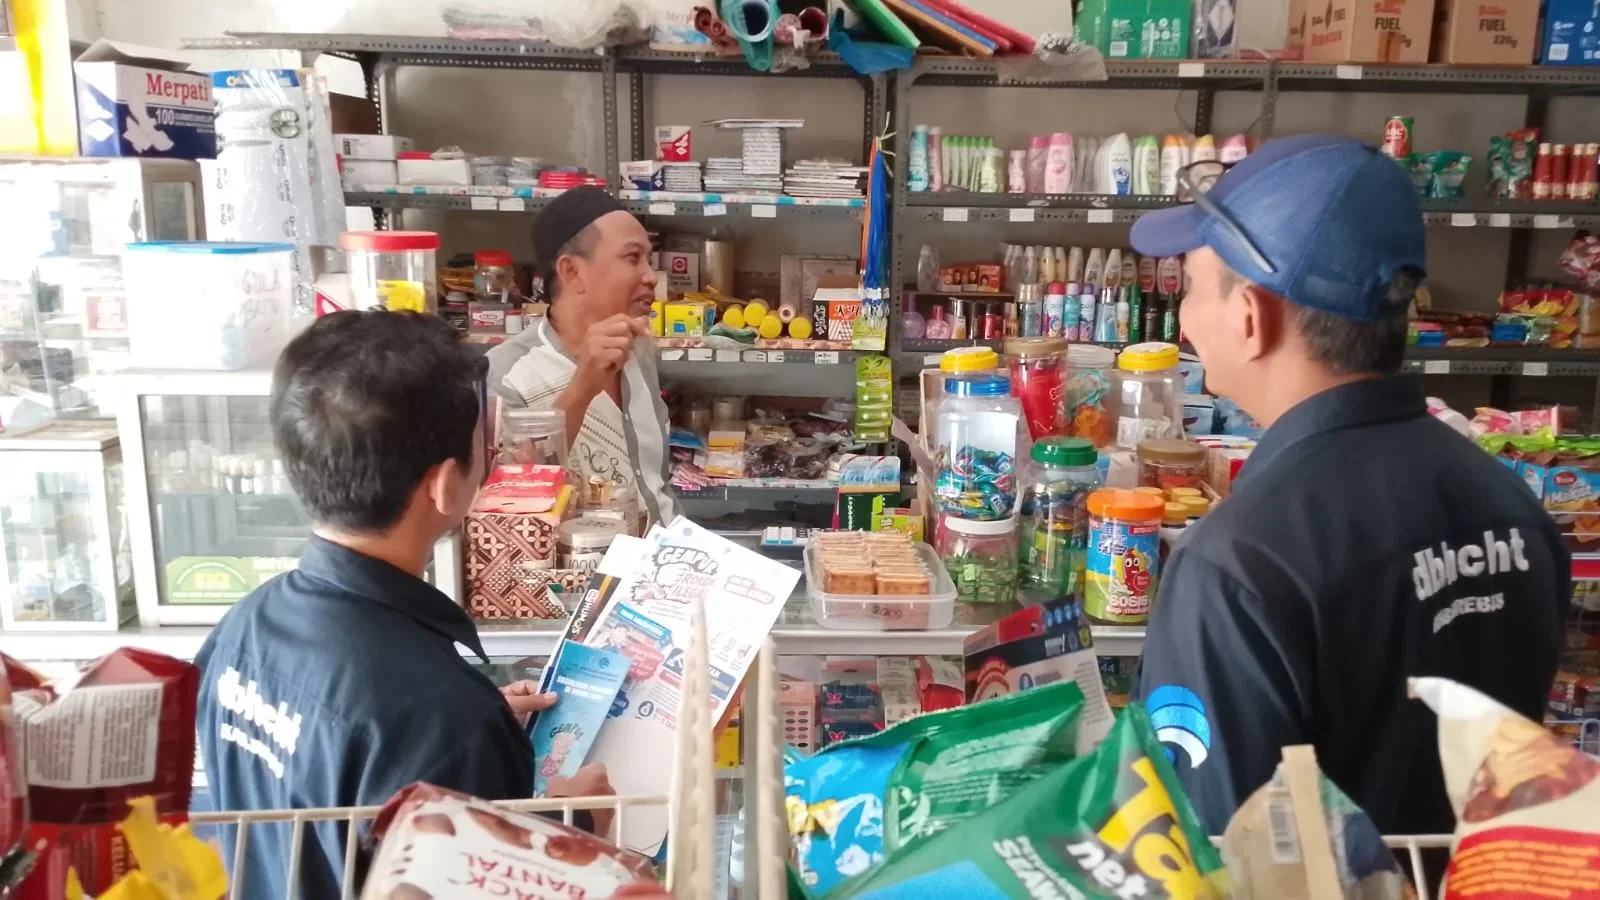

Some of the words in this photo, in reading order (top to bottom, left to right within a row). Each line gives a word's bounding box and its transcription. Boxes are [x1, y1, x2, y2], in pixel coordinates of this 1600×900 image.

[1375, 17, 1401, 30] FUEL
[1479, 18, 1506, 32] FUEL
[146, 72, 209, 105] Merpati
[155, 108, 175, 125] 100
[656, 545, 719, 576] GEMPUR
